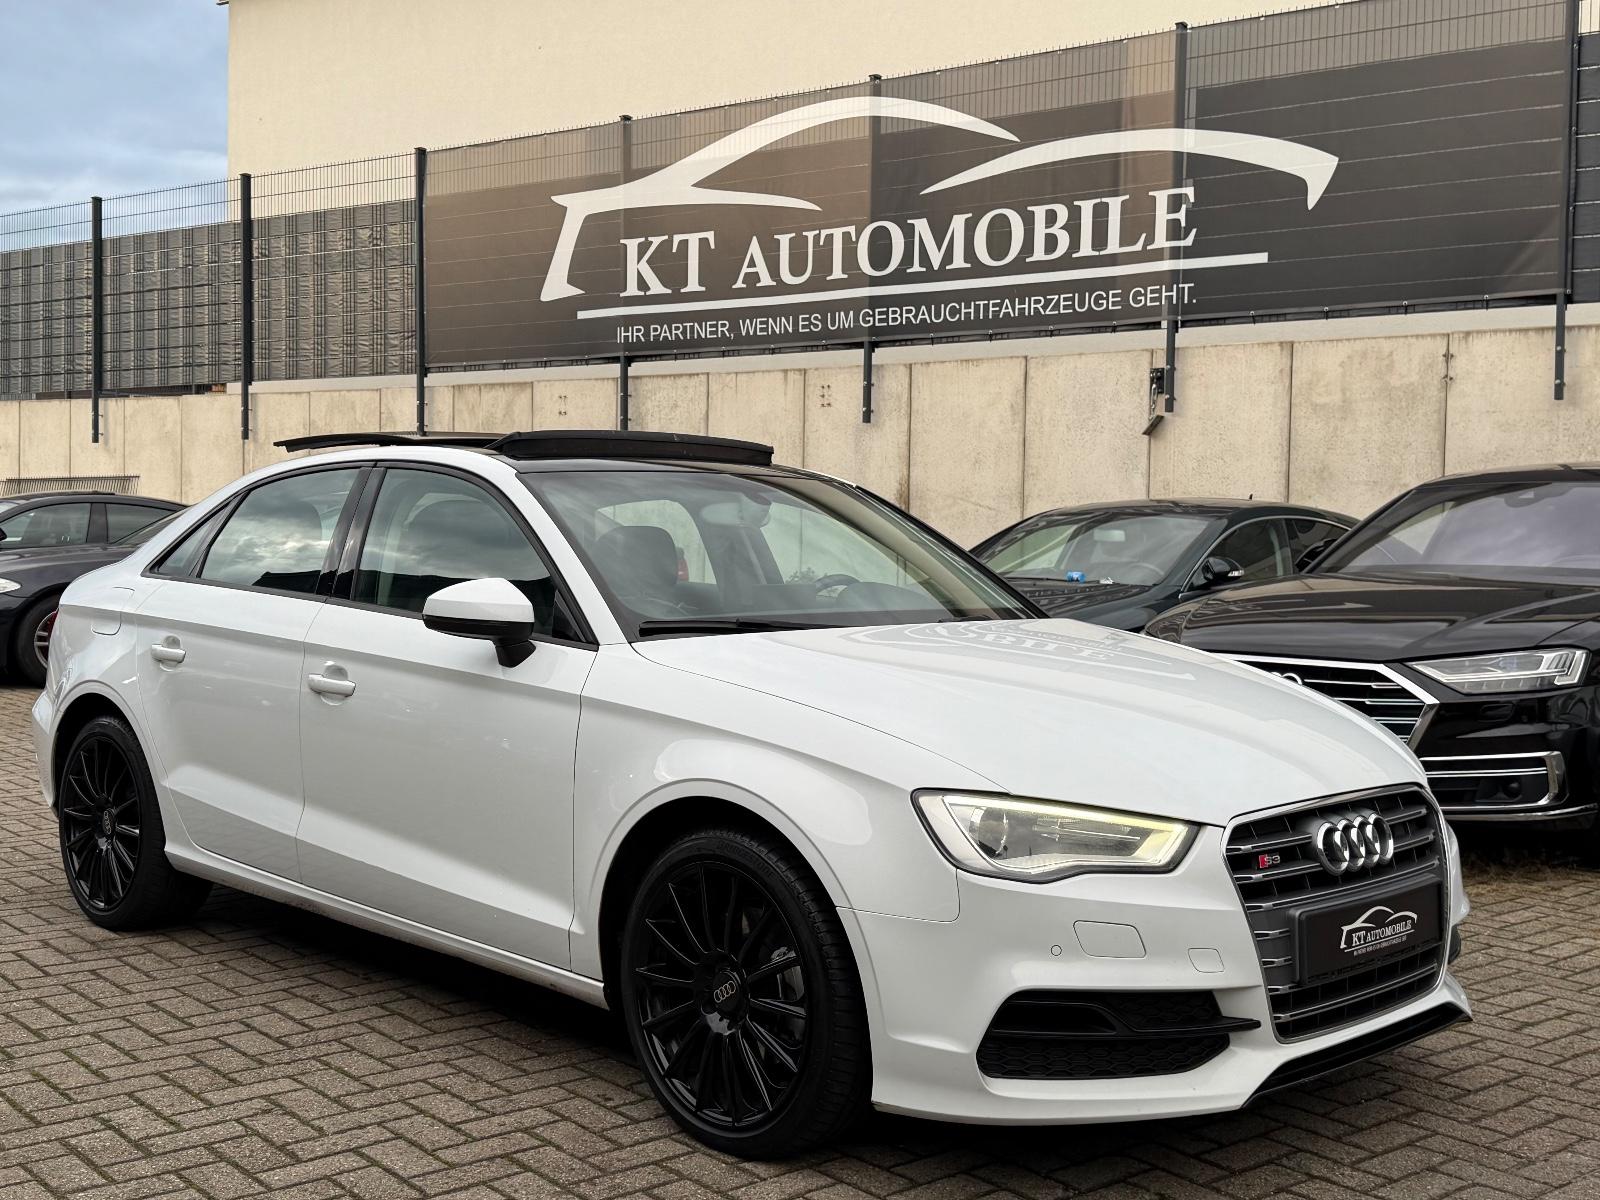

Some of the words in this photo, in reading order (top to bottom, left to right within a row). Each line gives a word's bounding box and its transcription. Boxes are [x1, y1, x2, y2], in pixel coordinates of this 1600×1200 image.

[619, 230, 715, 297] KT
[732, 186, 1197, 289] AUTOMOBILE
[617, 325, 645, 344] IHR
[650, 320, 734, 343] PARTNER,
[739, 315, 793, 337] WENN
[798, 313, 822, 333] ES
[827, 310, 854, 331] UM
[859, 289, 1122, 328] GEBRAUCHTFAHRZEUGE
[1129, 283, 1197, 308] GEHT.
[1351, 930, 1366, 947] KT
[1366, 920, 1412, 942] AUTOMOBILE
